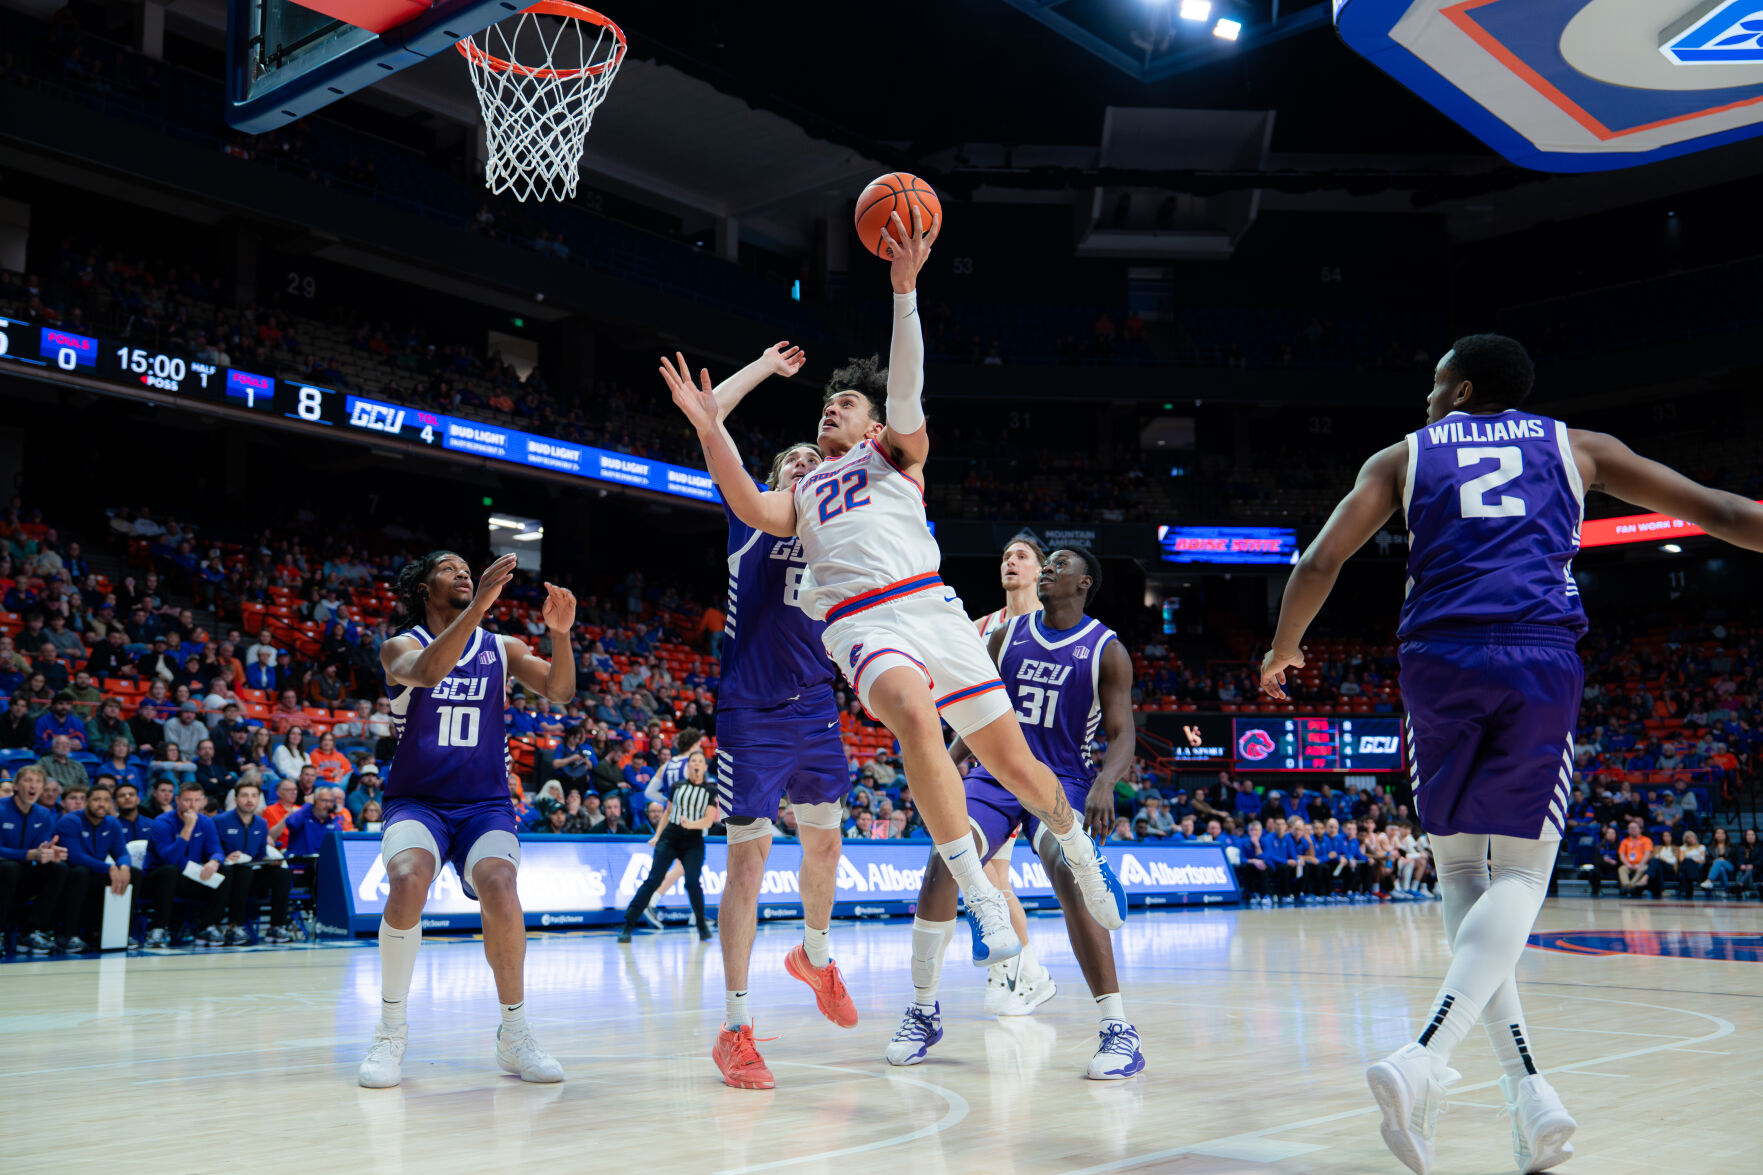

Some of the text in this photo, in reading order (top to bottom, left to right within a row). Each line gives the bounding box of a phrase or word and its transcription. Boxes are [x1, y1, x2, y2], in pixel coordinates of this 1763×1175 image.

[952, 257, 973, 273] 53
[287, 271, 317, 298] 29
[48, 332, 90, 350] FOULS
[58, 347, 77, 370] 0
[117, 346, 186, 381] 15:00
[191, 361, 216, 375] HALF
[147, 375, 179, 391] POSS
[200, 373, 208, 388] 1
[233, 373, 268, 389] FOULS
[245, 387, 254, 408] 1
[298, 387, 322, 421] 8
[350, 401, 405, 434] GCU
[418, 413, 439, 426] TOL
[420, 425, 434, 444] 4
[450, 424, 506, 446] BUD LIGHT
[1428, 419, 1545, 445] WILLIAMS
[528, 440, 580, 461] BUD LIGHT
[600, 456, 649, 476] BUD LIGHT
[667, 470, 688, 484] BUD
[687, 475, 713, 490] LIGHT
[1456, 446, 1526, 518] 2
[815, 467, 872, 526] 22
[1045, 530, 1096, 539] MOUNTAIN
[1616, 524, 1637, 534] FAN
[1638, 520, 1671, 532] WORK
[769, 539, 807, 563] GC
[1049, 539, 1092, 548] AMERICA
[1175, 538, 1283, 552] BOISE STATE
[1668, 570, 1686, 588] 11
[1016, 658, 1074, 686] GCU
[430, 677, 489, 700] GCU
[1015, 684, 1060, 728] 31
[436, 705, 480, 747] 10
[1285, 720, 1294, 731] 5
[1358, 736, 1400, 754] GCU
[1148, 861, 1227, 886] Albertsons
